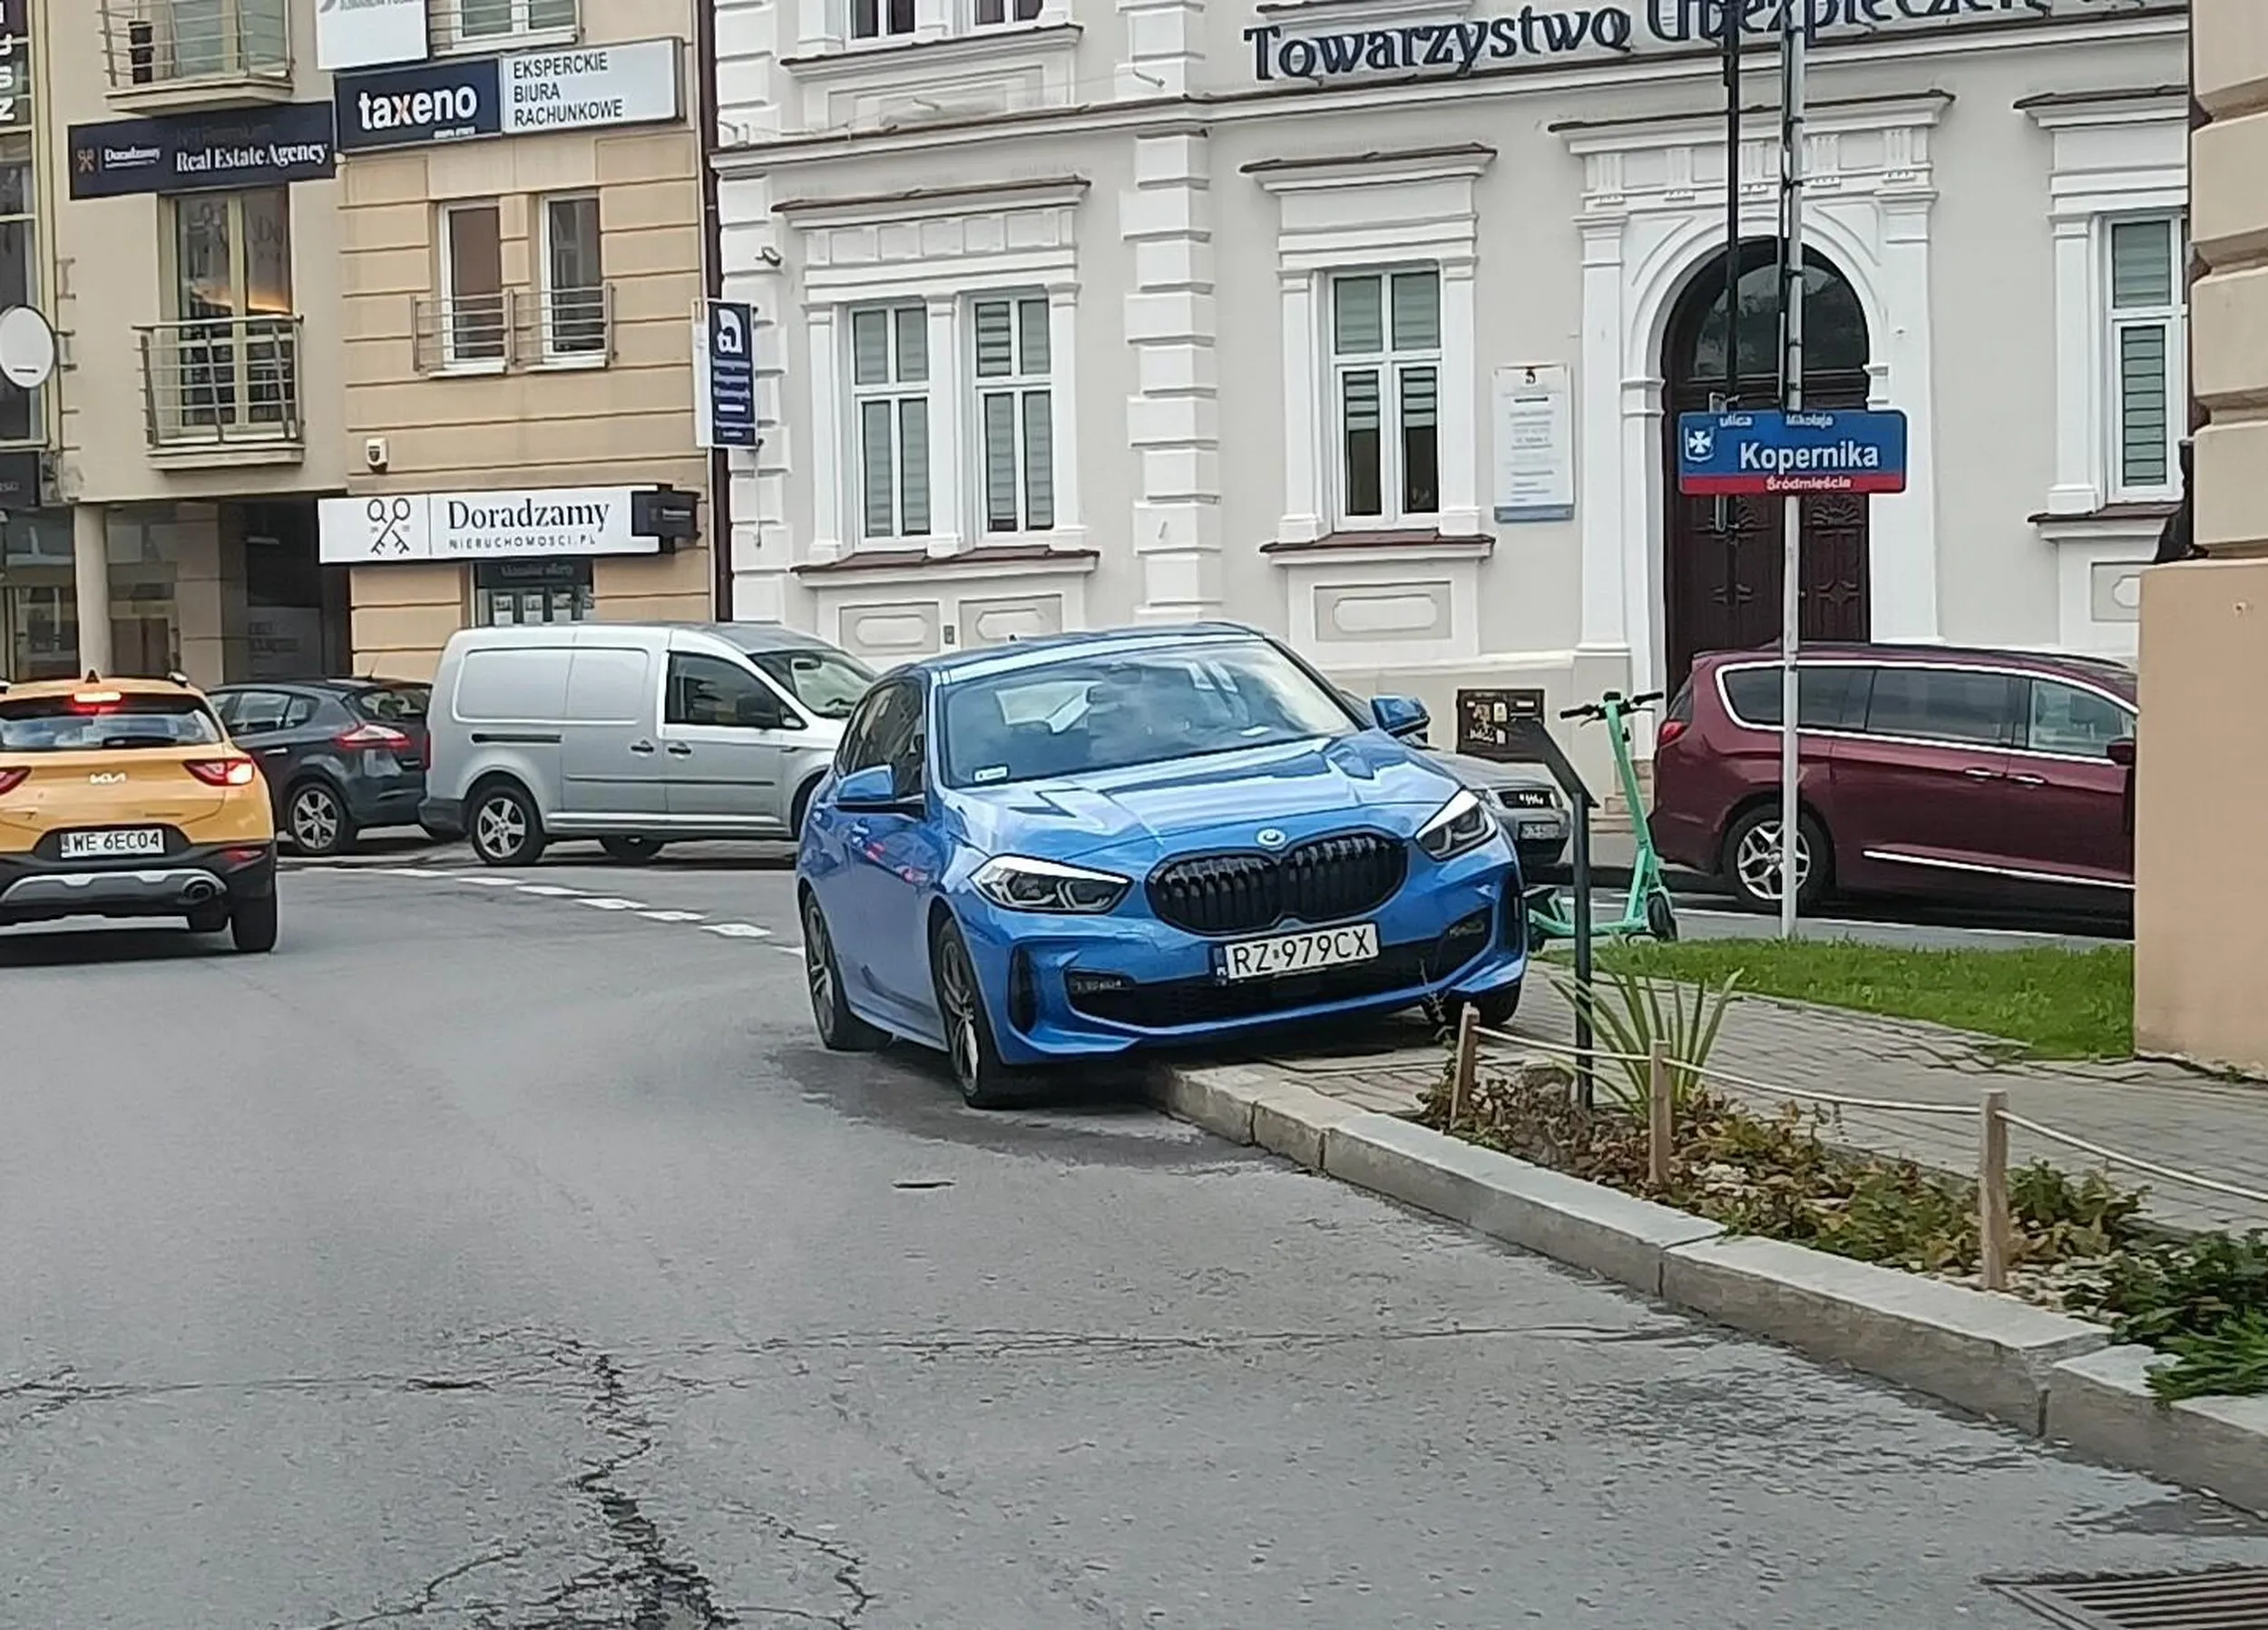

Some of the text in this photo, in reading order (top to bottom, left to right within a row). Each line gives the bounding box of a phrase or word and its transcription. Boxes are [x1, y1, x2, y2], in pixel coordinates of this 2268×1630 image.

[1244, 5, 1630, 82] Towarzystwo
[513, 52, 607, 79] EKSPERCKIE
[513, 82, 561, 102] BIURA
[359, 86, 477, 130] taxeno
[514, 99, 622, 127] RACHUNKOWE
[176, 142, 327, 172] Real Estate Agency
[1719, 414, 1753, 427] ulica
[1740, 440, 1879, 474] Kopernika
[1766, 475, 1852, 491] Śródmieście
[448, 498, 610, 532] Doradzamy
[73, 835, 96, 851] WE
